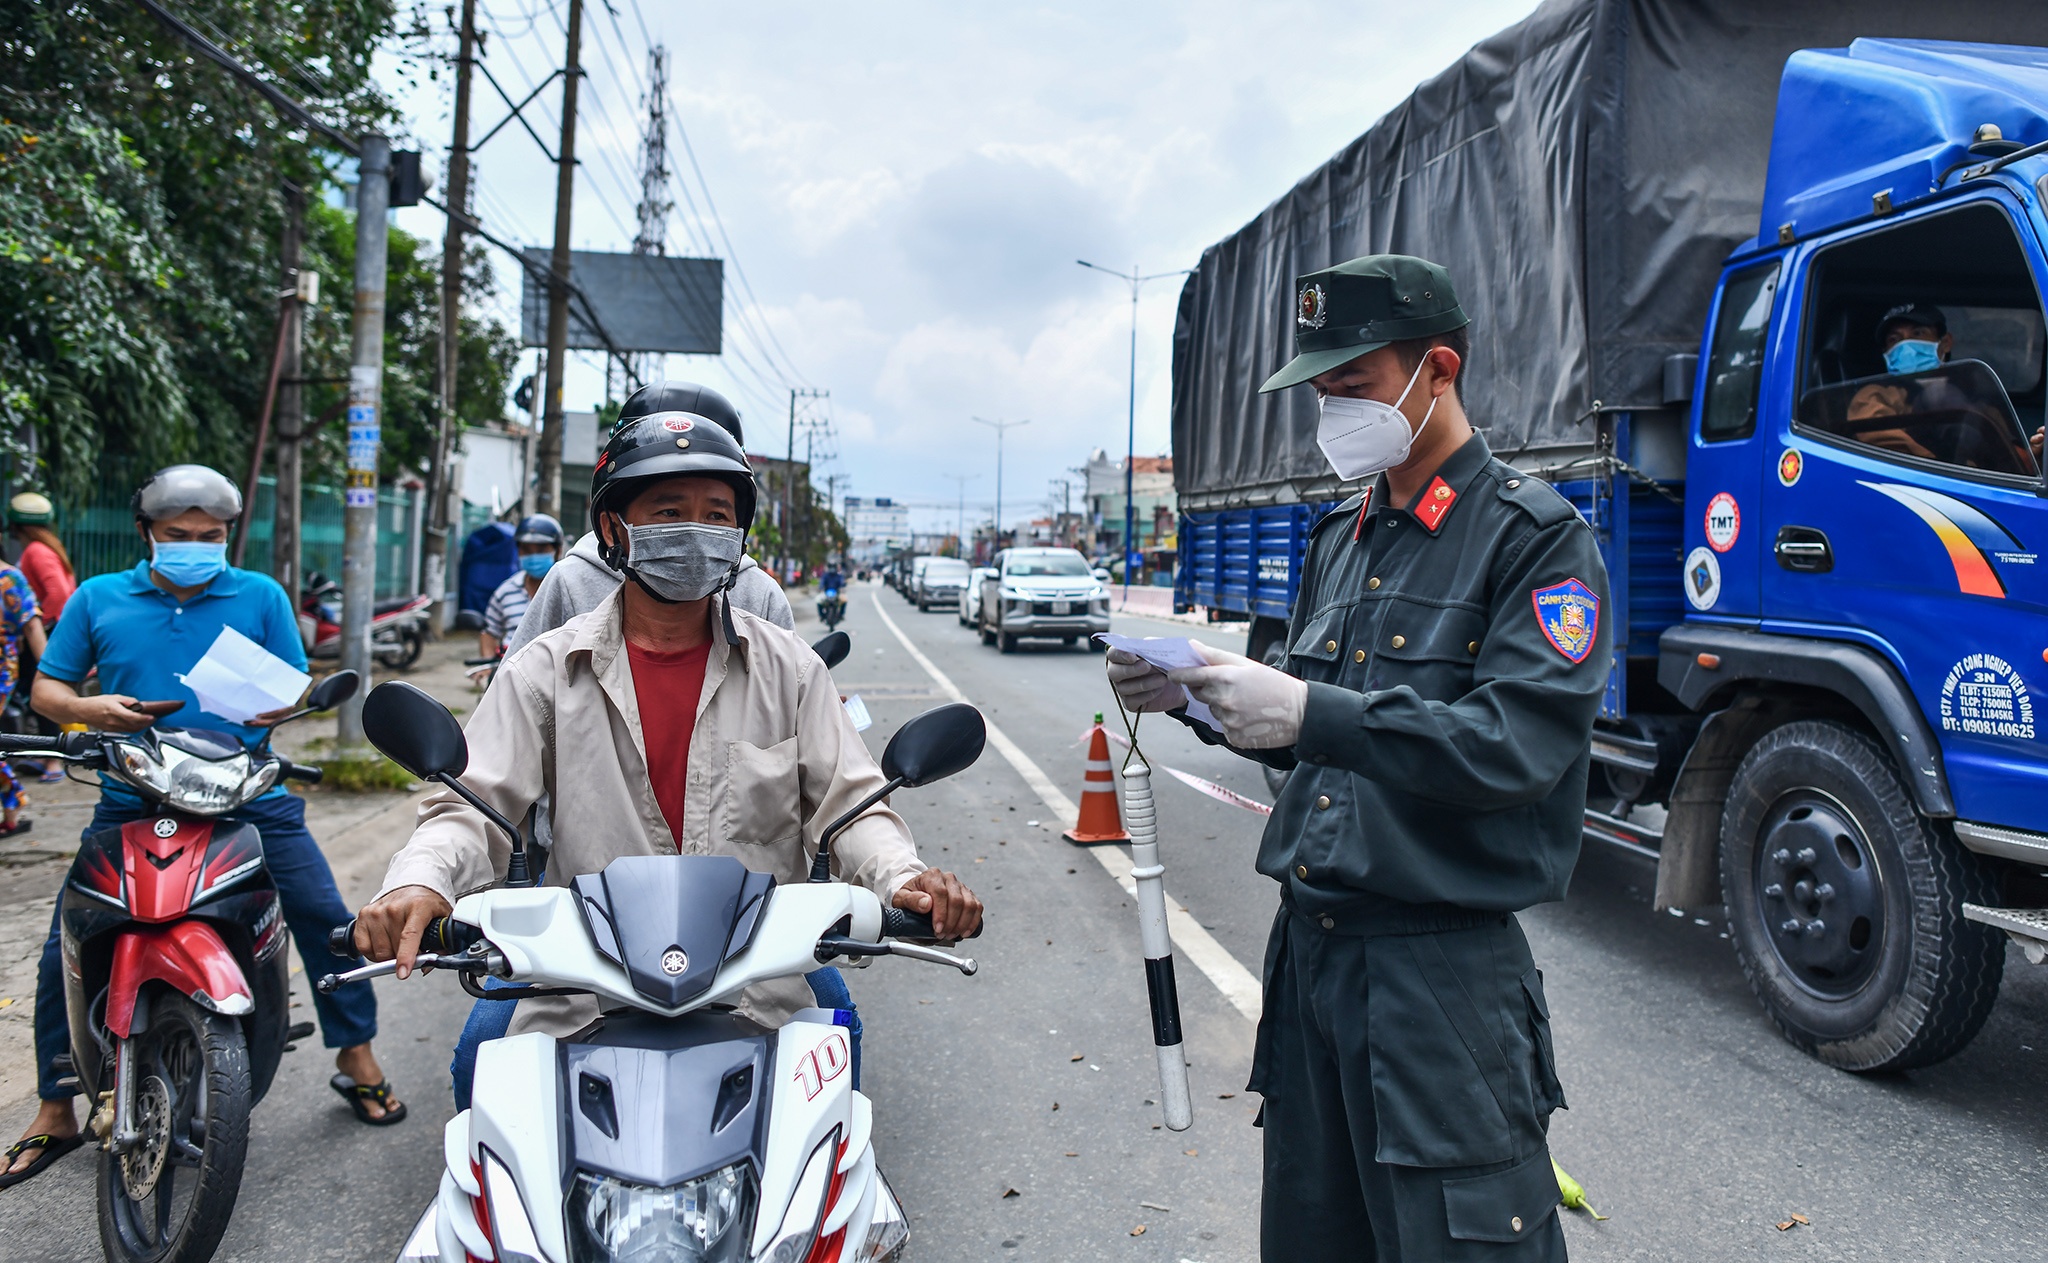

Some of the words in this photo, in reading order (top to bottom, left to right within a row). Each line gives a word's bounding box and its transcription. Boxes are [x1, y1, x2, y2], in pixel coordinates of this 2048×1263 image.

[1711, 516, 1734, 529] TMT
[1941, 697, 1952, 716] CTY
[1953, 661, 1965, 679] PT
[1963, 653, 1983, 672] CONG
[1984, 653, 2012, 678] NGHIEP
[2008, 671, 2027, 697] VIEN
[1974, 672, 1996, 684] 3N
[1959, 685, 1981, 697] TLBT:
[1981, 687, 2012, 699] 4150KG
[1959, 696, 1982, 708] TLCP:
[1982, 698, 2013, 710] 7500KG
[1981, 709, 2014, 721] 11845KG
[1962, 718, 2036, 739] 0908140625
[794, 1034, 848, 1102] 10
